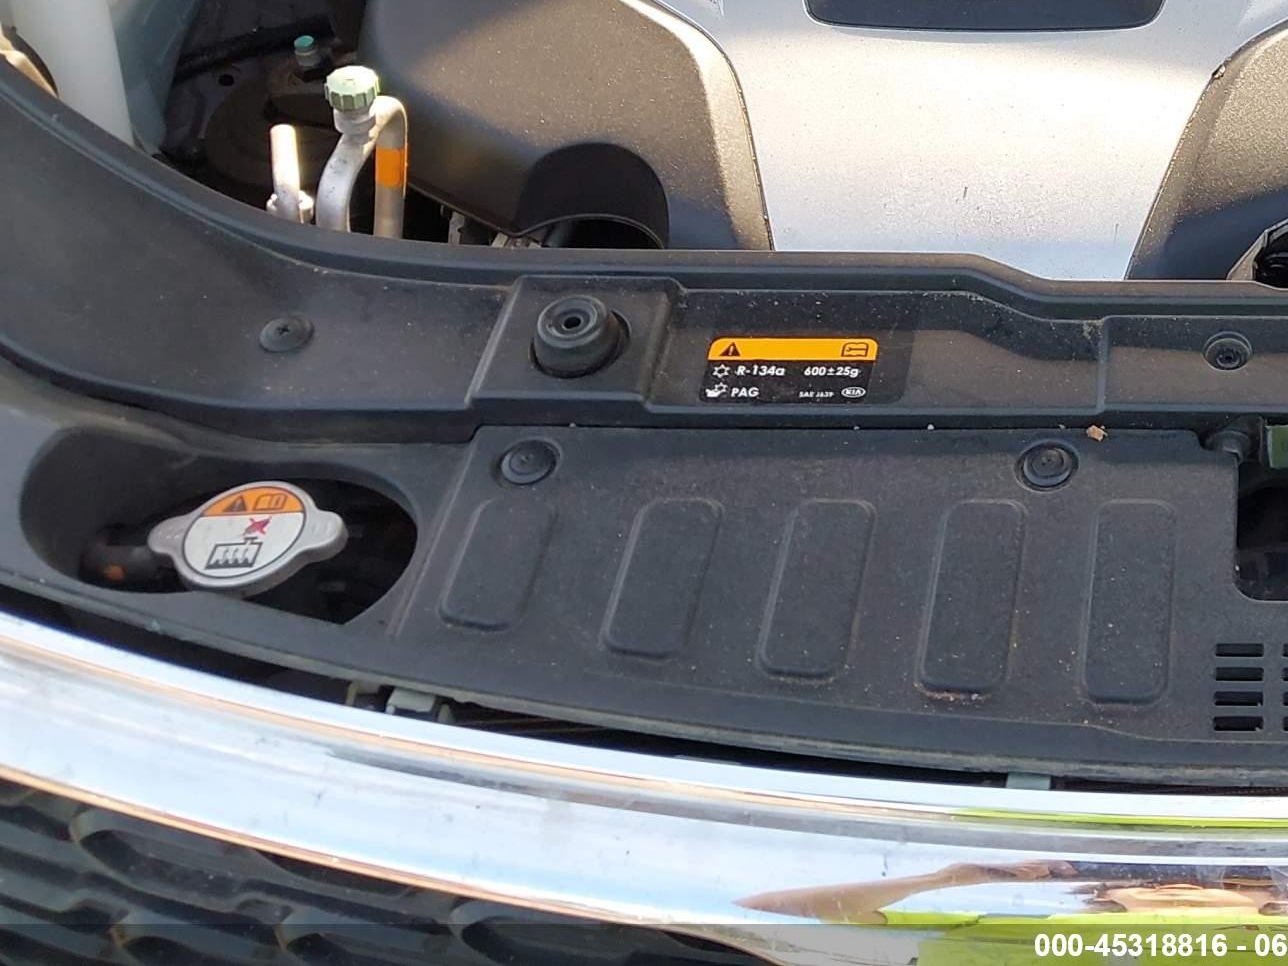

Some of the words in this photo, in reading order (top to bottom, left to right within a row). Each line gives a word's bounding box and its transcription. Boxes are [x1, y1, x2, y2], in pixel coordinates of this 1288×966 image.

[736, 365, 786, 377] R-134a
[804, 366, 860, 378] 600±25g
[730, 387, 760, 398] PAG
